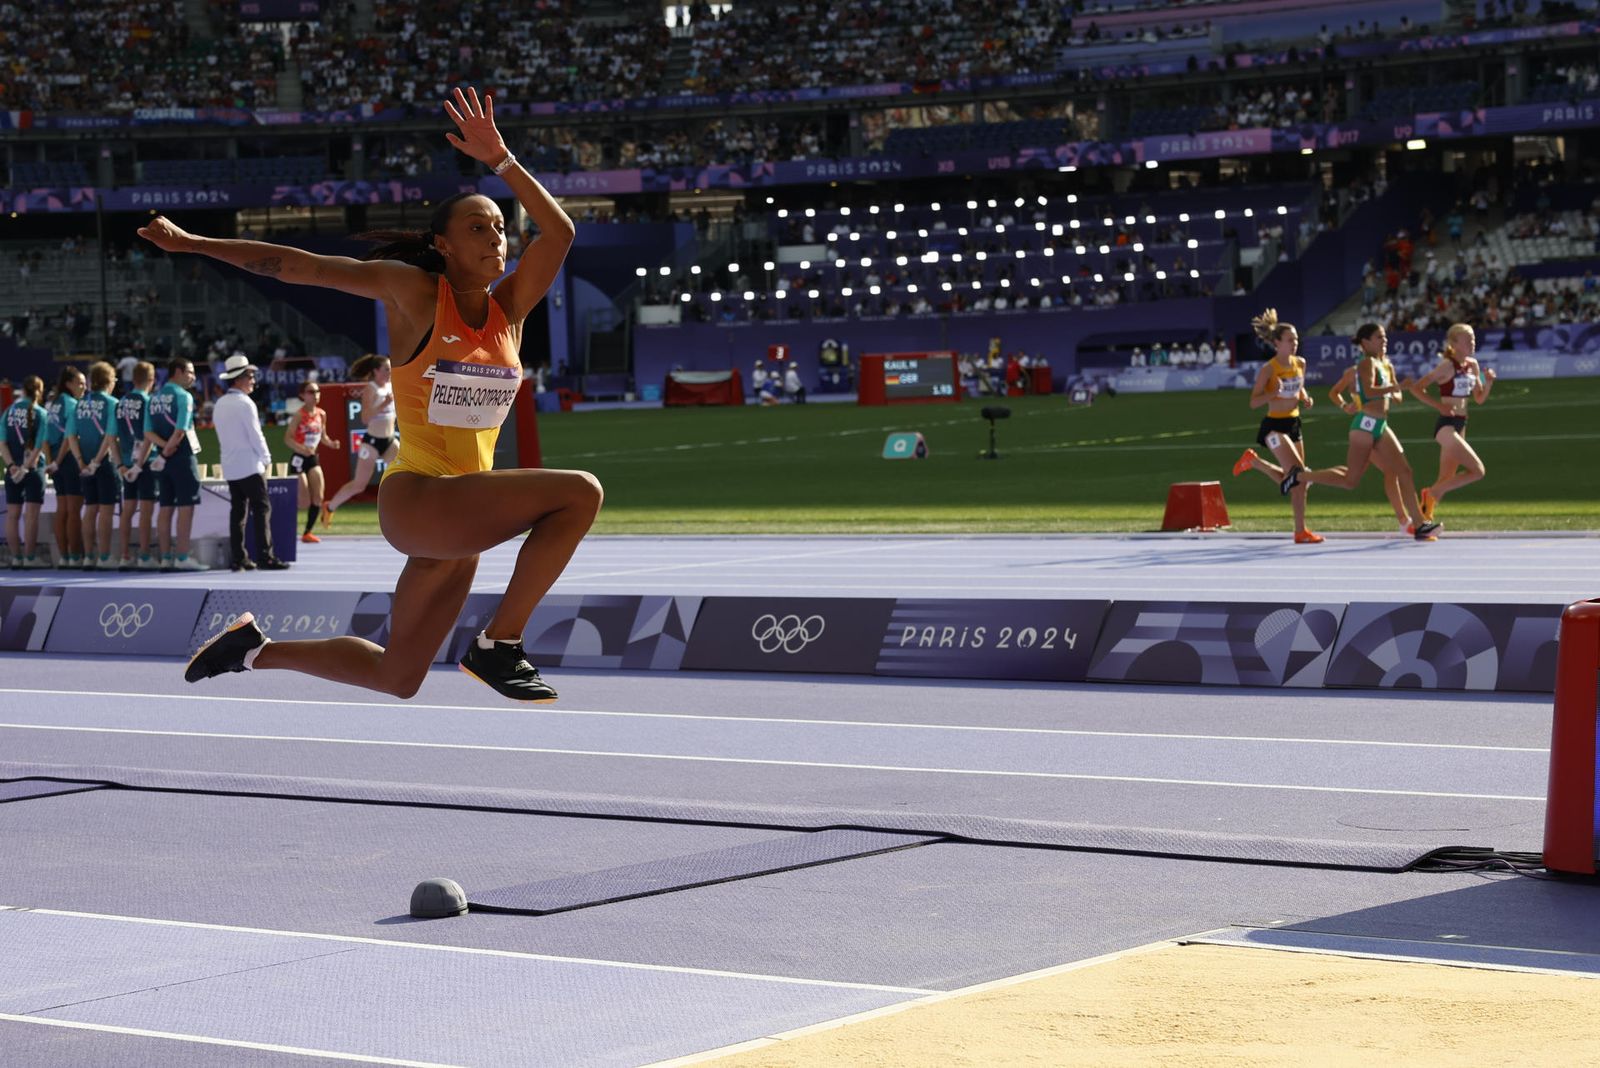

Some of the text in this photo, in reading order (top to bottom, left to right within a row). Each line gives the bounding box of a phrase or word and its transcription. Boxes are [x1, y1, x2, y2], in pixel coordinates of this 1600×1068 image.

[1161, 136, 1254, 154] PARIS 2024
[807, 161, 901, 176] PARIS 2024
[131, 190, 229, 204] PARIS 2024
[461, 365, 506, 376] PARIS 2024
[280, 614, 340, 633] 2024
[900, 626, 1077, 649] PARIS 2024
